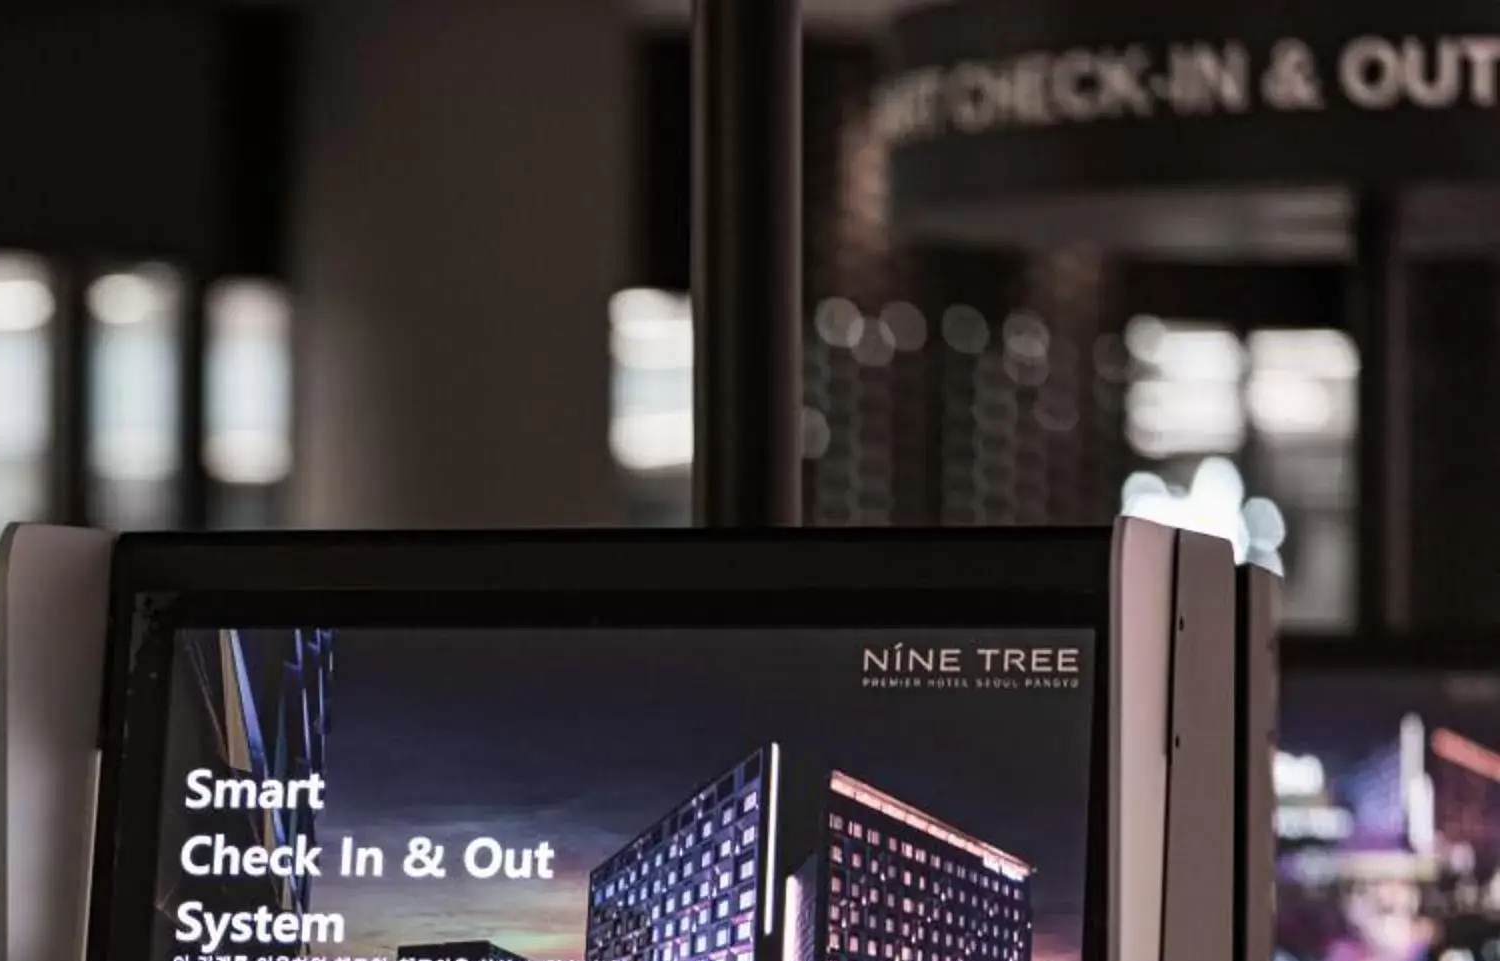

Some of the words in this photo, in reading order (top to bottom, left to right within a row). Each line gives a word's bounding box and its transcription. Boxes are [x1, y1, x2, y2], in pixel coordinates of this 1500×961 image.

[1262, 40, 1323, 109] &
[1338, 36, 1500, 108] OUT
[976, 649, 1079, 672] TREE
[862, 677, 921, 688] PREMIER
[927, 678, 969, 688] HOTEL
[976, 678, 1019, 689] SEOUL
[184, 768, 326, 810] Smart
[180, 834, 322, 876] Check
[340, 837, 384, 876] In
[402, 838, 446, 878] &
[464, 838, 555, 879] Out
[175, 901, 345, 953] System
